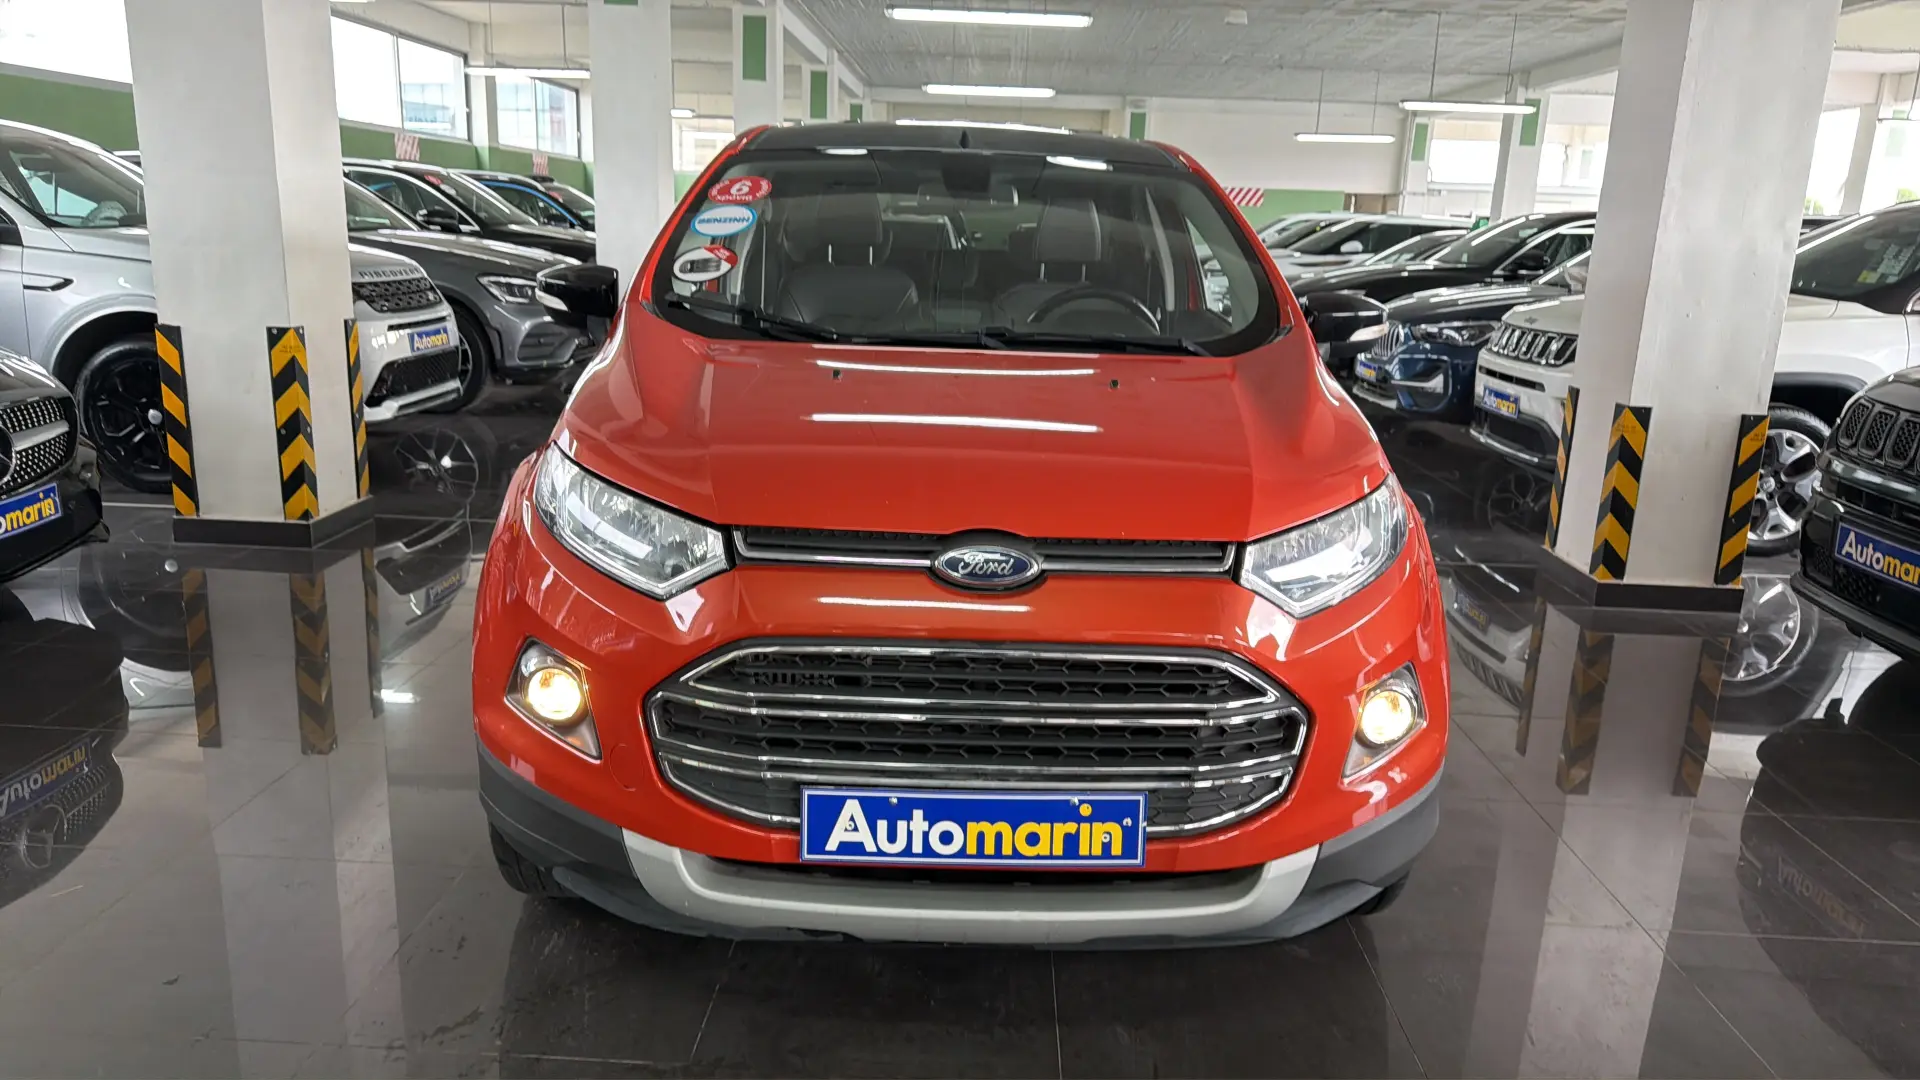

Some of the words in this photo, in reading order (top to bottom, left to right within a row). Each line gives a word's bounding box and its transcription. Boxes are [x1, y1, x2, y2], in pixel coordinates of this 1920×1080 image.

[730, 180, 752, 195] 6
[414, 329, 449, 351] Automarin
[955, 551, 1015, 576] Ford
[824, 798, 1123, 857] Automarin
